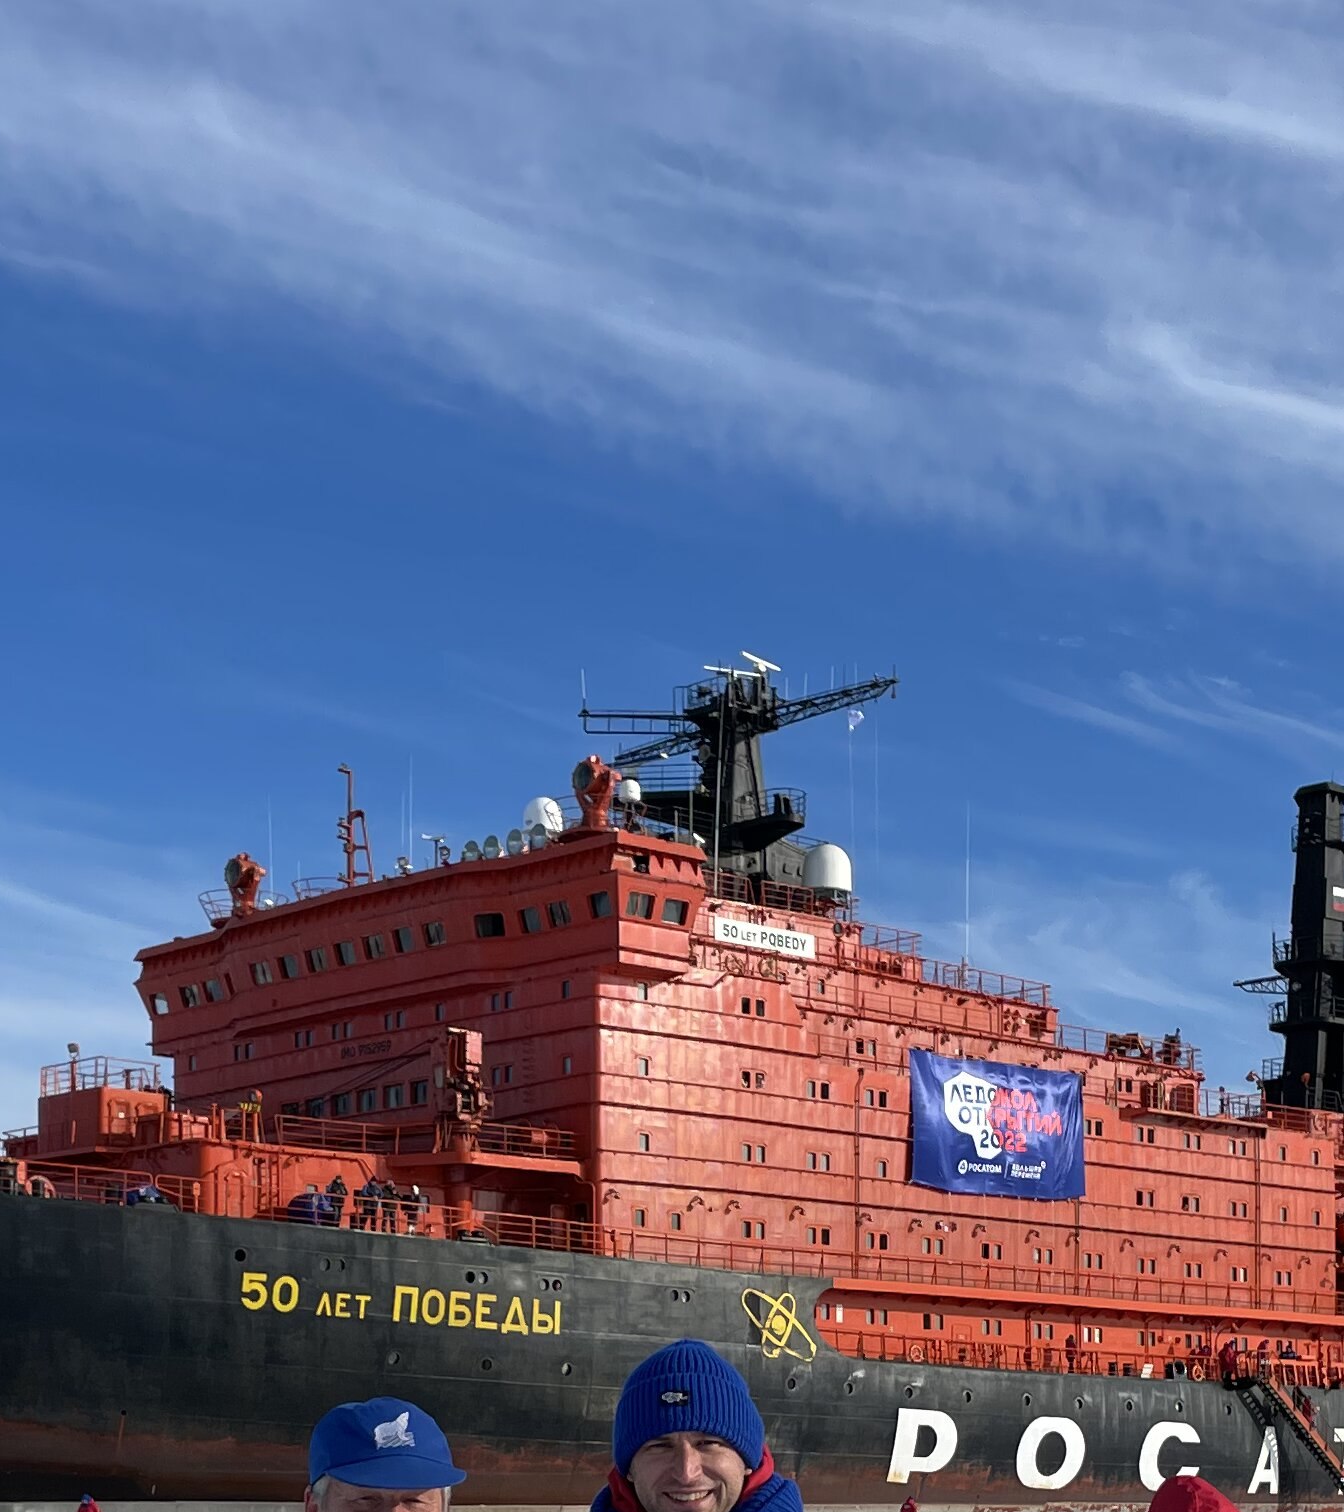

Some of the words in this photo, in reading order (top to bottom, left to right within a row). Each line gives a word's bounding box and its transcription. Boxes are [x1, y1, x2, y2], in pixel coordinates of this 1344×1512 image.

[722, 923, 738, 938] 50
[741, 930, 757, 942] LET
[760, 931, 807, 951] POBEDY
[950, 1083, 1037, 1112] ЛЕДОКОЛ
[958, 1105, 1062, 1136] ОТКРЫТИЙ
[980, 1129, 1027, 1153] 2022
[968, 1162, 1002, 1173] РОСАТОМ
[241, 1271, 299, 1313] 50
[392, 1284, 562, 1336] ПОБЕДЫ
